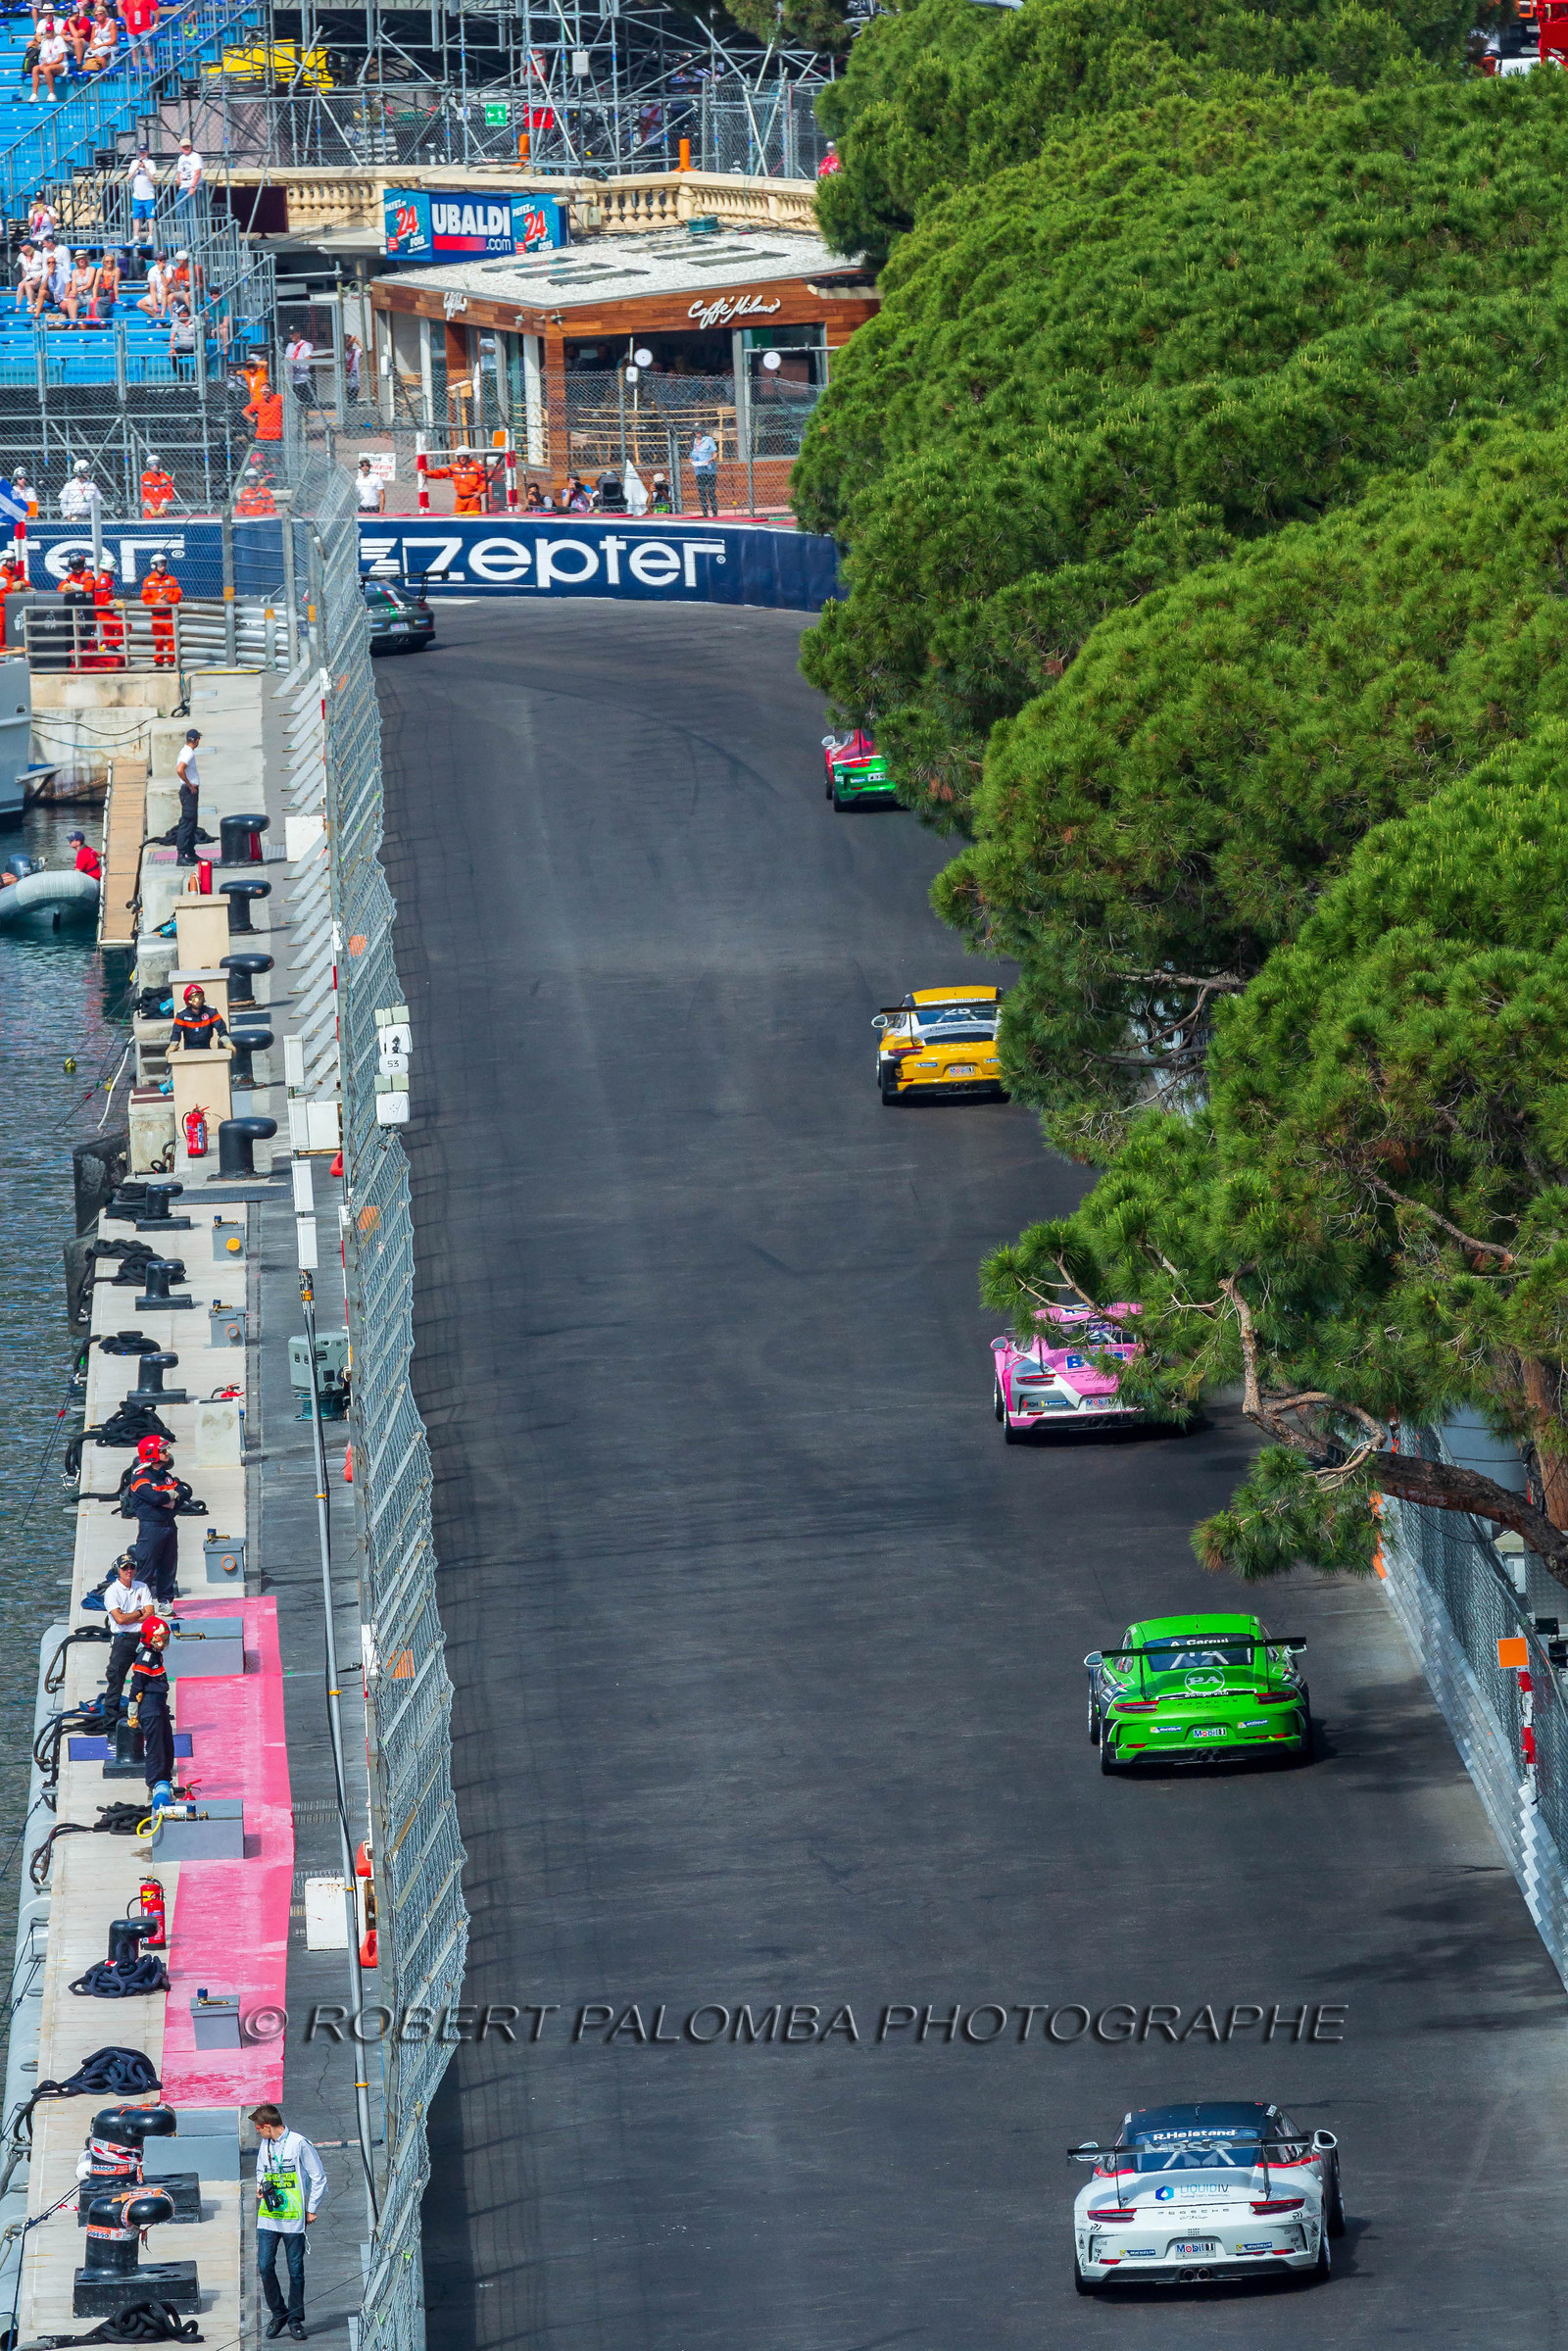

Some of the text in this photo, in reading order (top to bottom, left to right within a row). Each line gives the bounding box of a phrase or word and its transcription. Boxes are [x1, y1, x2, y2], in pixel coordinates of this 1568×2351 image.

[395, 205, 419, 238] 24
[431, 203, 512, 236] UBALDI
[523, 210, 548, 243] 24
[486, 238, 512, 251] .com
[387, 1059, 400, 1068] 53
[1187, 1676, 1222, 1686] PA
[1193, 1728, 1217, 1738] Mobil
[1176, 2242, 1214, 2253] Mobil 1
